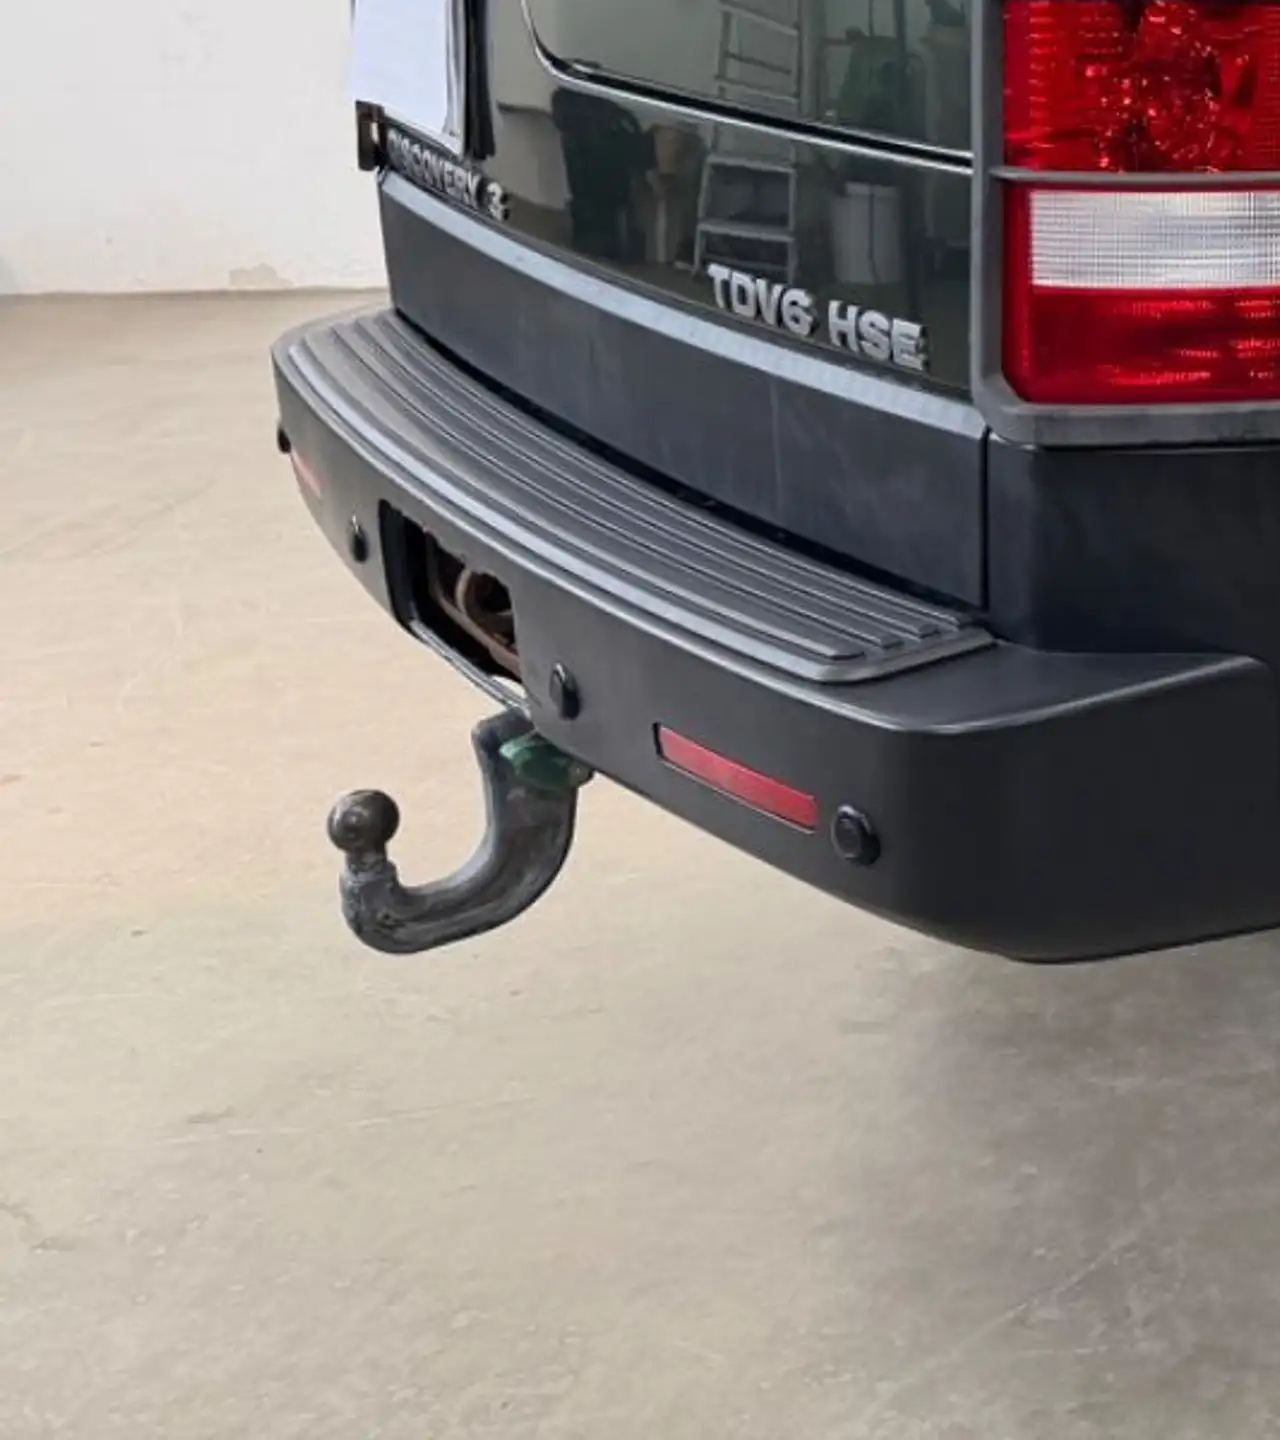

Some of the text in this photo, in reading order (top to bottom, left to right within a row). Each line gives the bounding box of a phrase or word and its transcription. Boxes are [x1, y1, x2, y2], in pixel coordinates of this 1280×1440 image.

[486, 181, 506, 221] 3
[707, 263, 928, 371] TDV6 HSE
